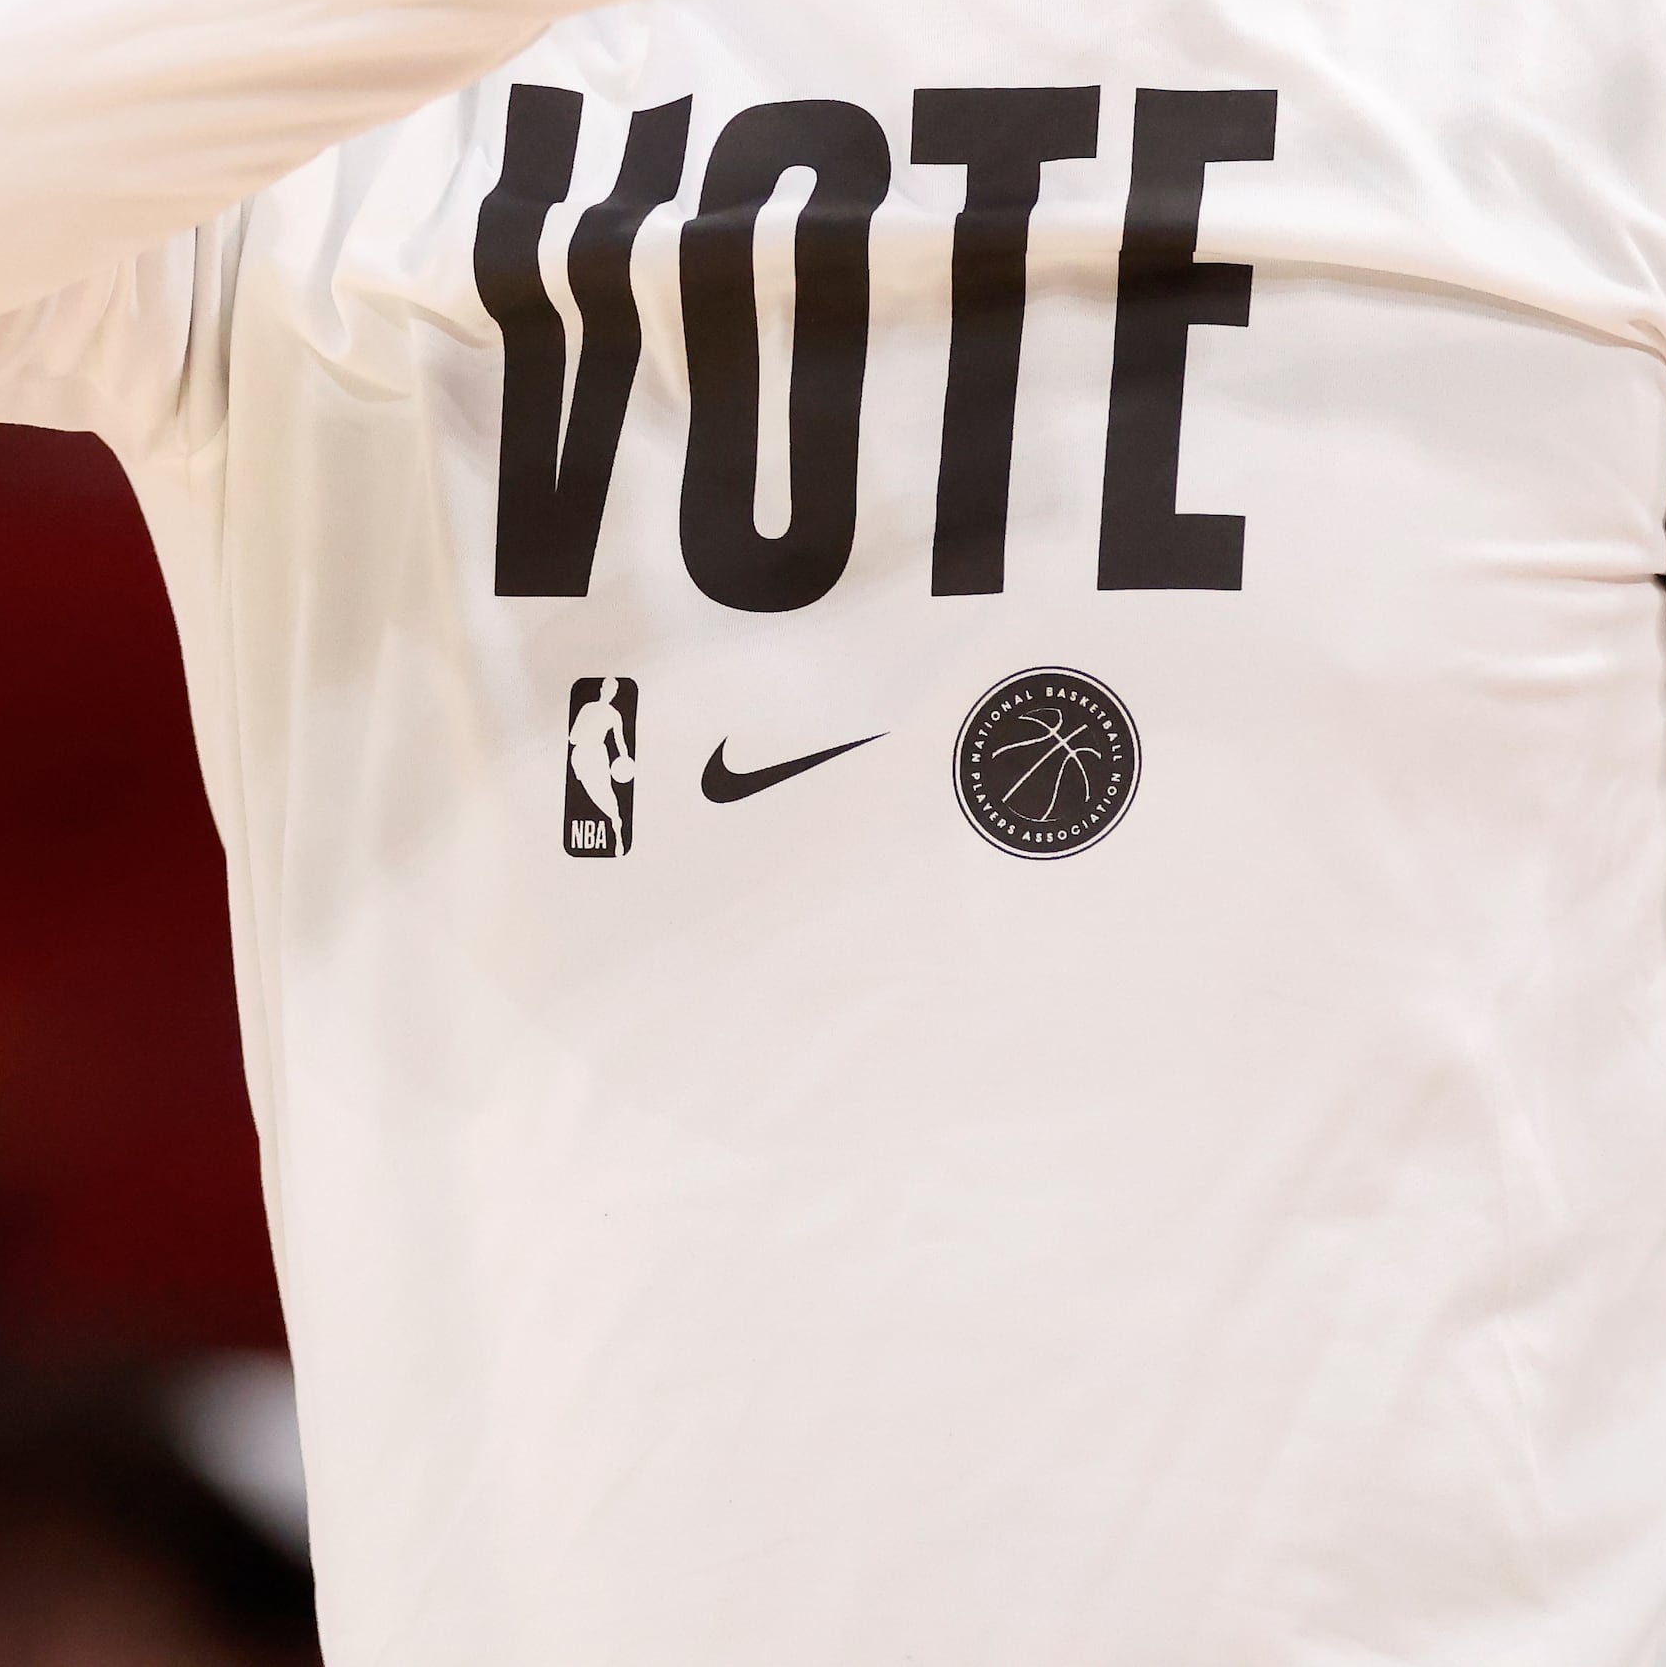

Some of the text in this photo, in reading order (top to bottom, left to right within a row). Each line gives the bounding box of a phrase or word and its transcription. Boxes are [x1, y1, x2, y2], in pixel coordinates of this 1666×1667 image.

[474, 84, 1277, 612] VOTE
[971, 686, 1122, 762] NATIONAL BASKETBALL
[571, 820, 607, 849] NBA
[971, 772, 1121, 843] PLAYERS ASSOCIATION
